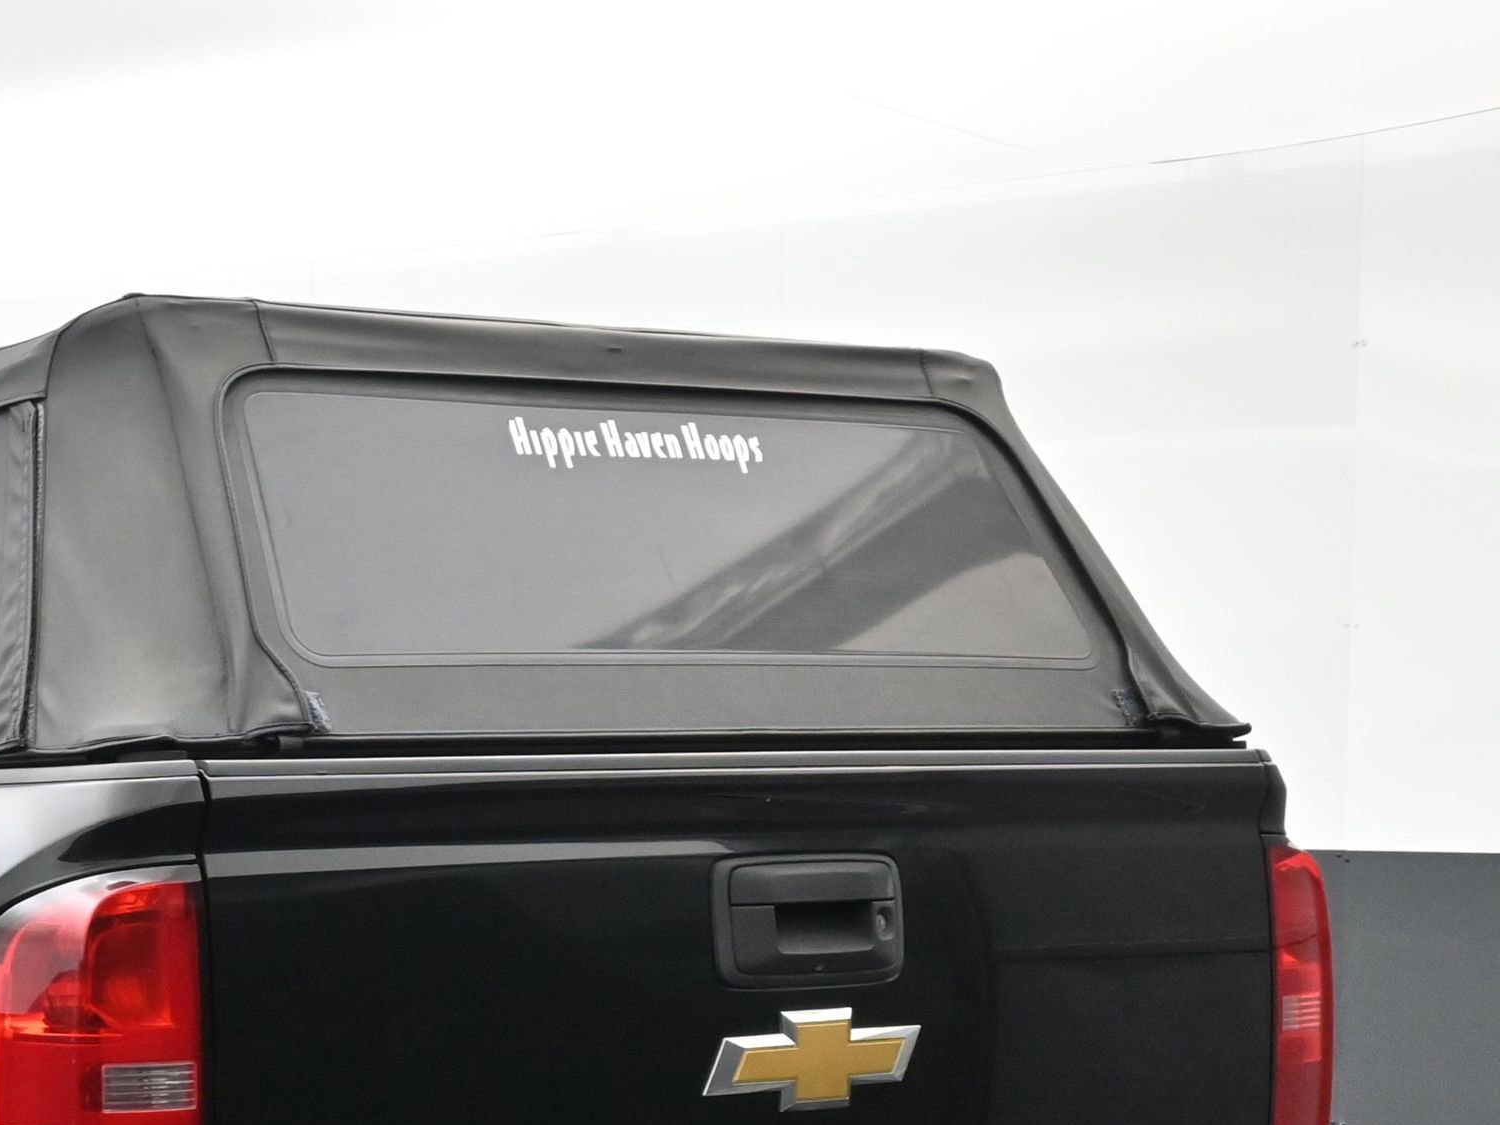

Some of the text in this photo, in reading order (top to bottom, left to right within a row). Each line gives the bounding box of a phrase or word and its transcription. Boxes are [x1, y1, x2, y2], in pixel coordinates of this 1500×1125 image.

[508, 416, 764, 474] Hippie Haven Hoops
